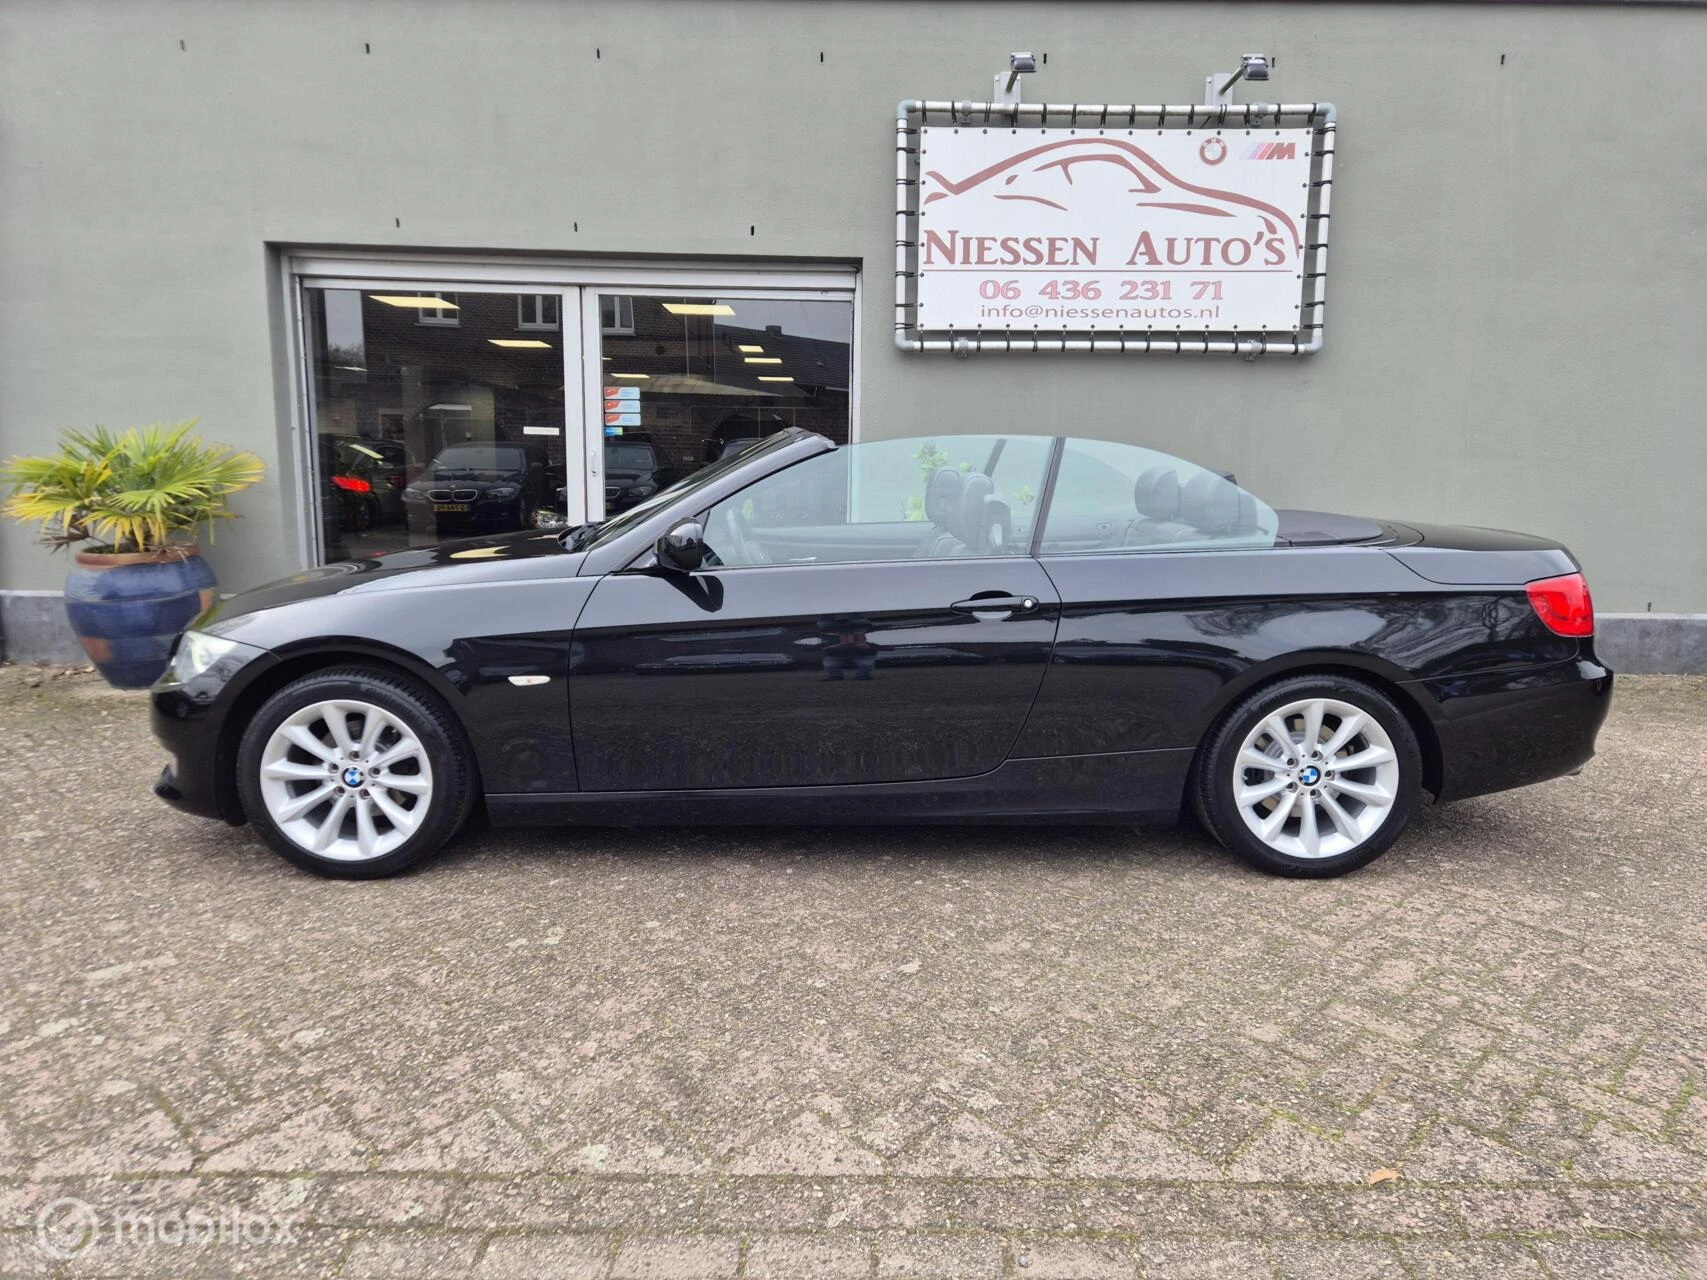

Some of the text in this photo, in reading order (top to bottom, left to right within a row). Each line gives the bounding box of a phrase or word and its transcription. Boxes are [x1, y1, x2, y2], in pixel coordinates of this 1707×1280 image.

[924, 230, 1286, 266] NIESSEN AUTO'S
[979, 280, 1224, 301] 06 436 231 71
[980, 304, 1220, 319] info@niessenautos.nl
